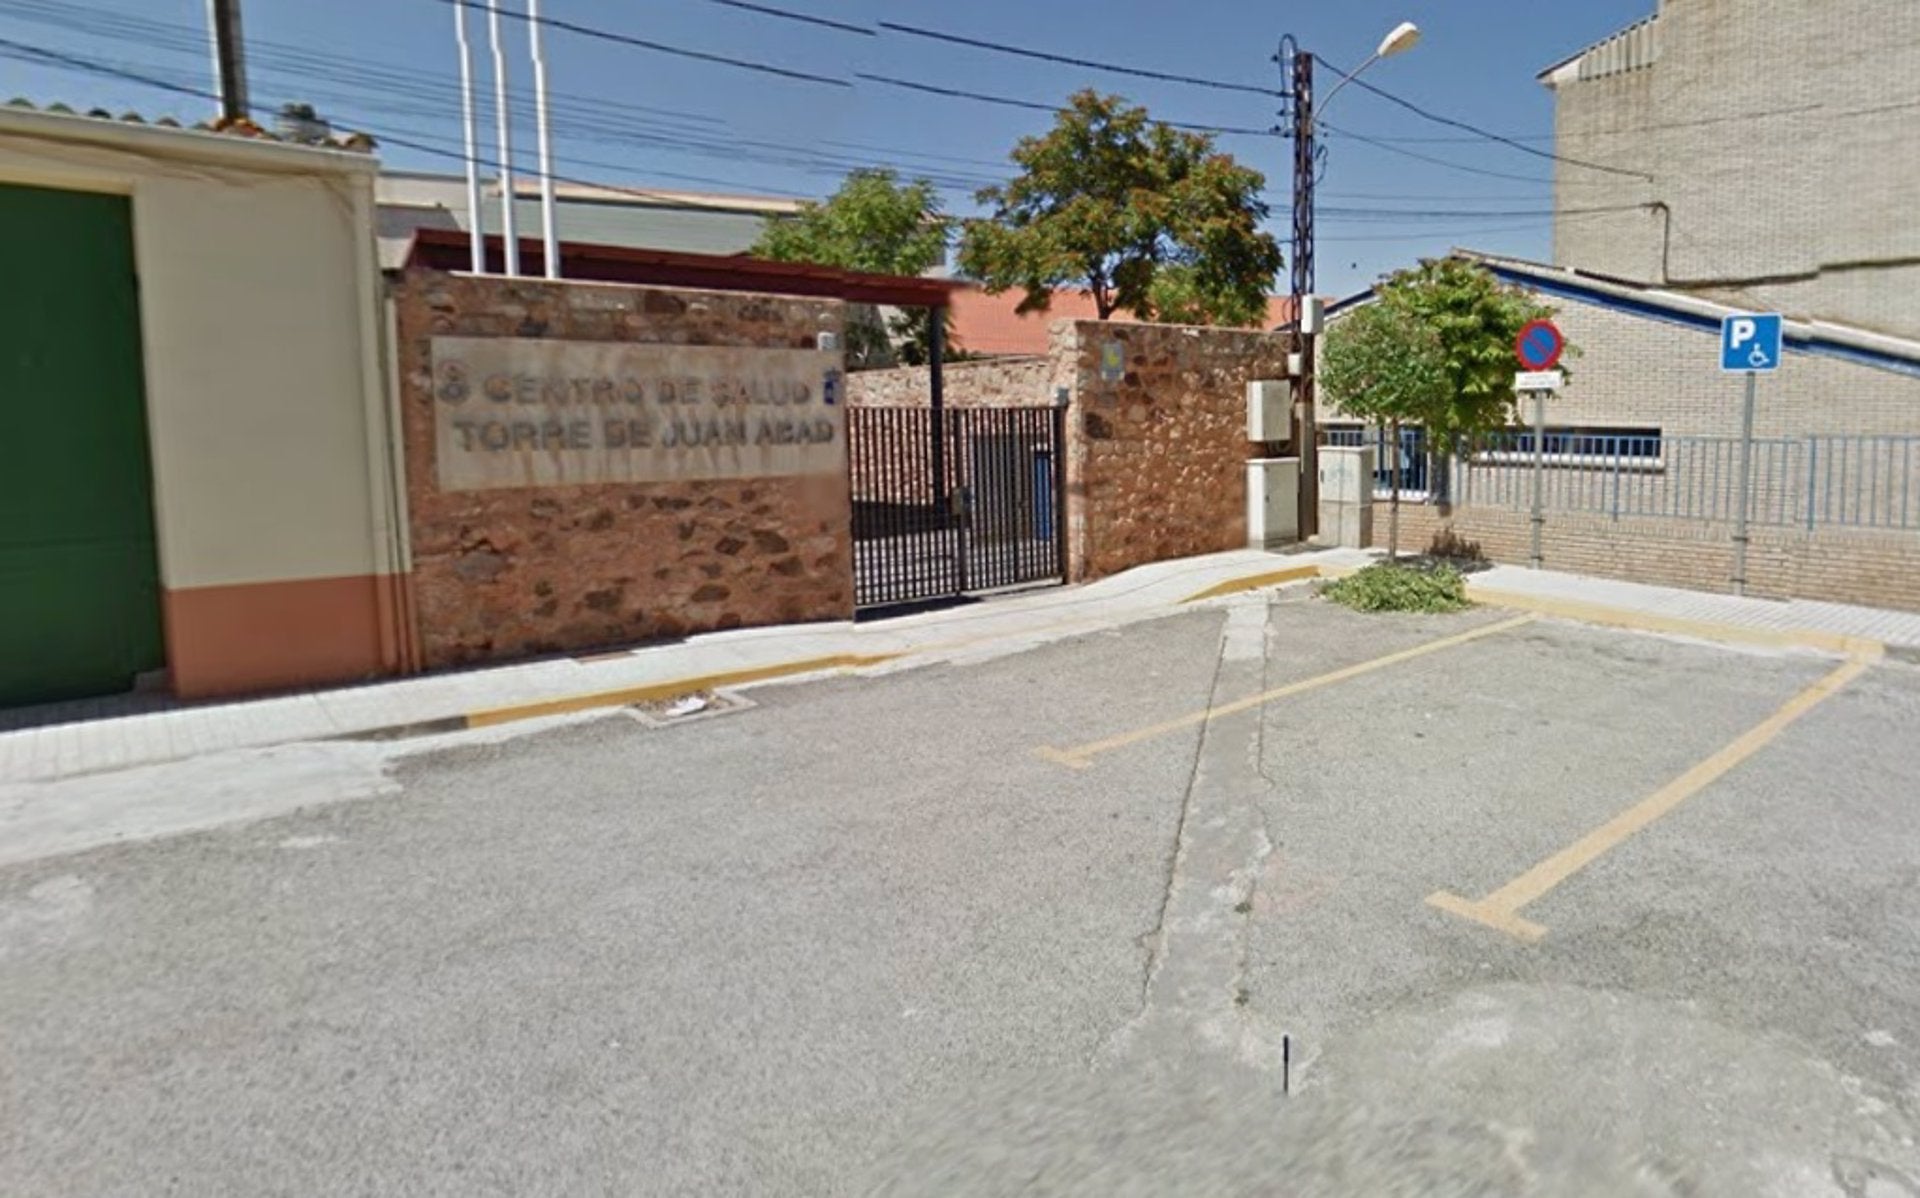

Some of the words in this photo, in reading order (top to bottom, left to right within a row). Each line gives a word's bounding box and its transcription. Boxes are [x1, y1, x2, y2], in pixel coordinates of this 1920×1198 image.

[1730, 319, 1756, 349] P
[484, 375, 646, 406] CENTRO
[660, 377, 701, 405] DE
[711, 379, 811, 407] SALUD
[453, 419, 593, 452] TORRE
[604, 420, 652, 450] DE
[663, 419, 748, 448] JUAN
[754, 418, 834, 446] ABAD
